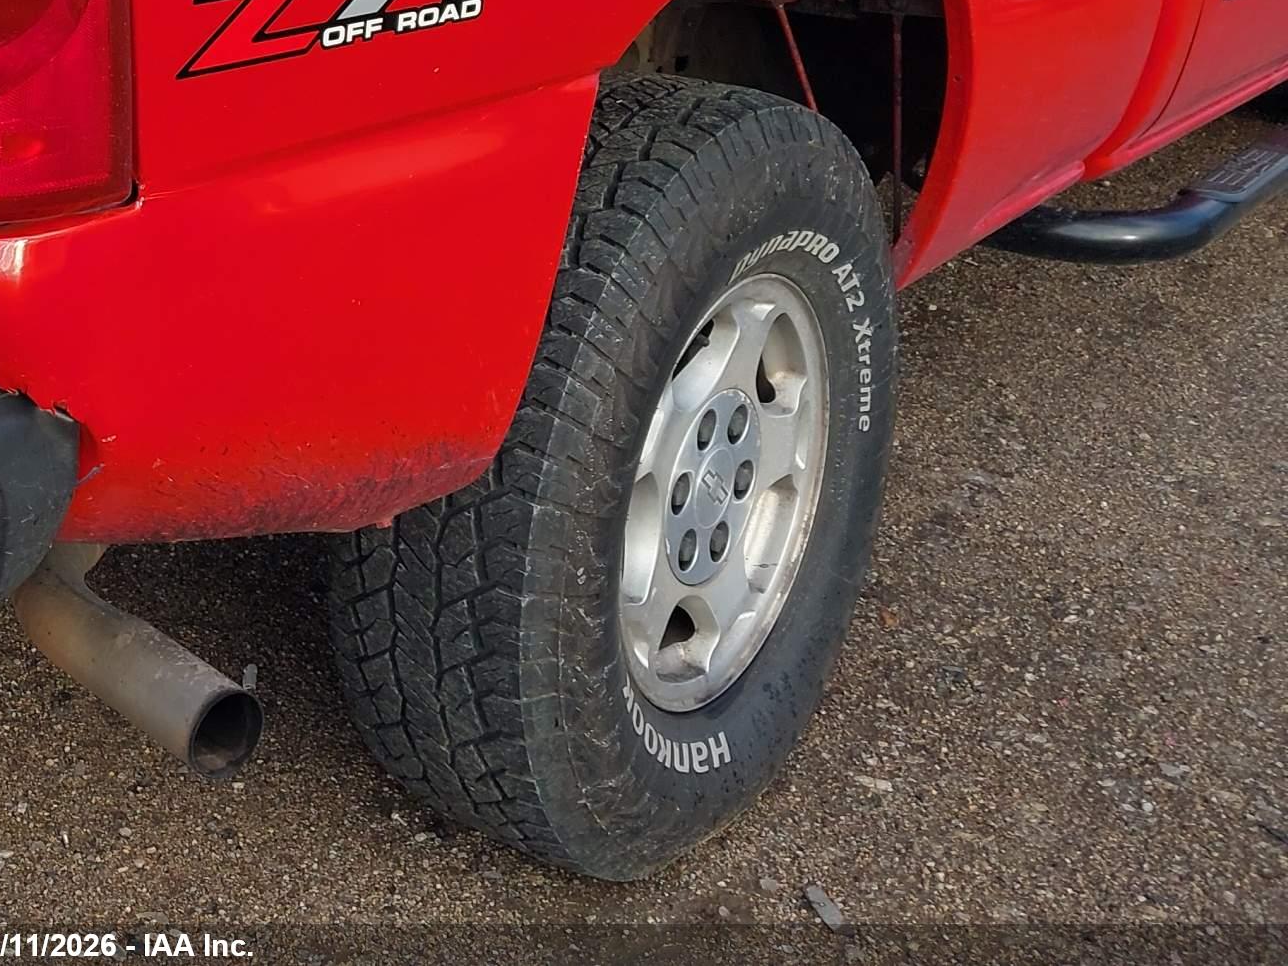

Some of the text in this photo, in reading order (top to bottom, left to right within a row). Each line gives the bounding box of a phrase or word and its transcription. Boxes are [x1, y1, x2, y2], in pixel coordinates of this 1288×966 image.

[322, 17, 383, 48] OFF
[831, 263, 865, 313] AT2
[852, 317, 873, 433] Xtreme
